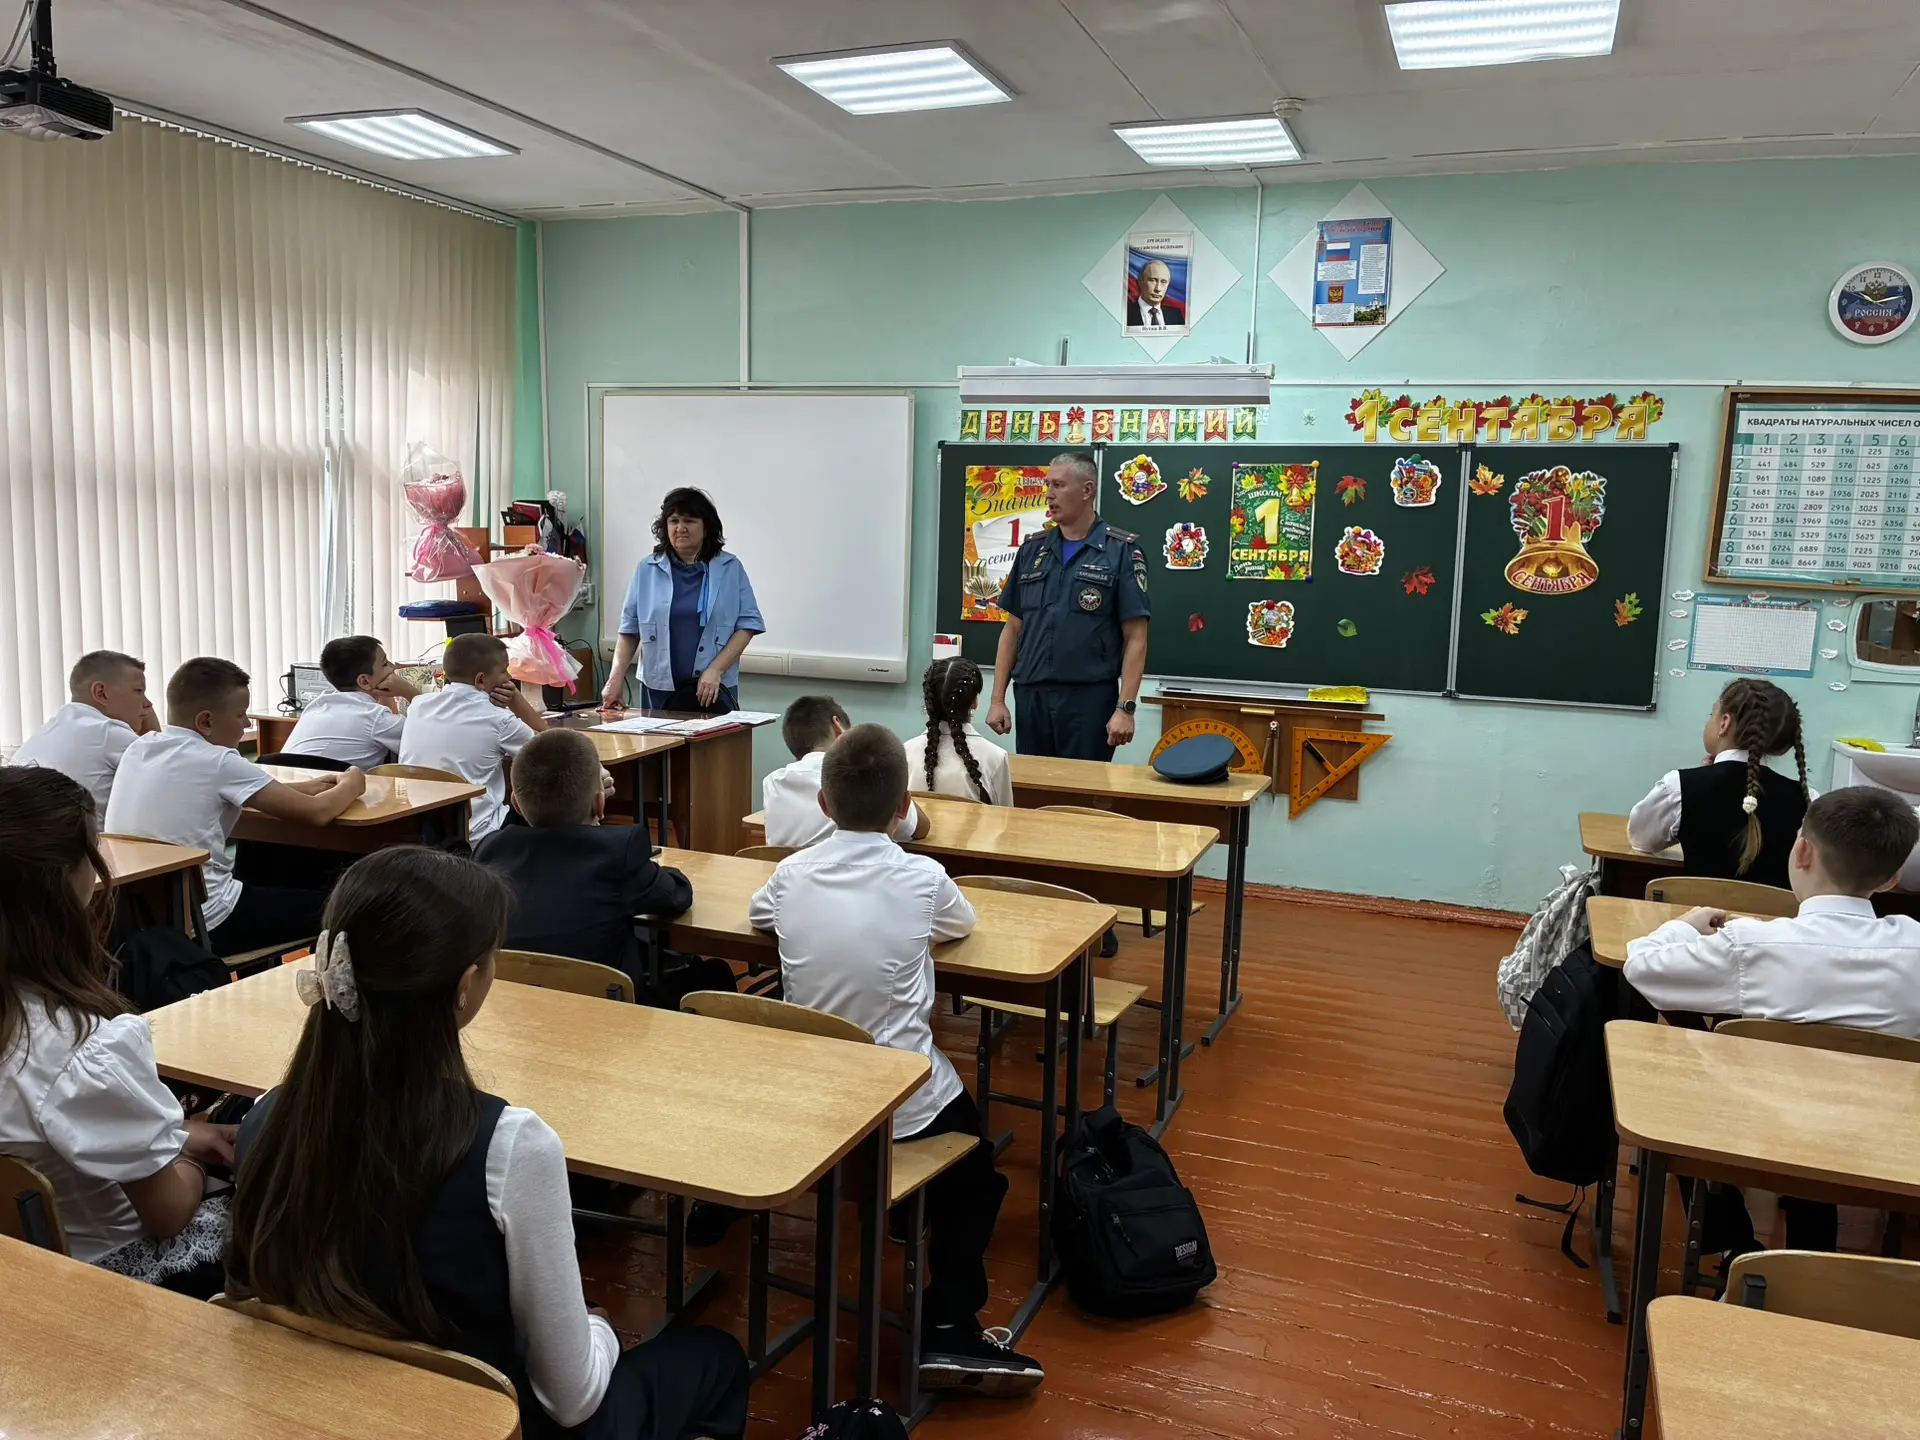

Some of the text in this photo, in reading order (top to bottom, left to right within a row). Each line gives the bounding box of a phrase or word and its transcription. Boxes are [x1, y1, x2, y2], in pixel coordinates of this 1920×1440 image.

[1854, 308, 1892, 316] РОССИЯ
[963, 408, 1254, 435] ДЕНЬ ЗНАНИЙ
[1354, 399, 1648, 442] 1 СЕНТЯБРЯ
[1748, 418, 1800, 426] КВАДРАТЫ
[1764, 433, 1907, 446] 1 2 3 4 5 6
[1740, 444, 1744, 455] 1
[1736, 458, 1744, 469] 2
[1734, 472, 1742, 483] 3
[1248, 490, 1282, 499] ШКОЛА!
[1733, 486, 1740, 497] 4
[971, 482, 1050, 515] Знани
[1732, 500, 1738, 511] 5
[1254, 498, 1280, 544] 1
[1541, 496, 1567, 542] 1
[1730, 514, 1737, 525] 6
[1008, 518, 1020, 548] 1
[1729, 528, 1736, 538] 7
[1726, 541, 1734, 552] 8
[988, 552, 1016, 565] сент
[1232, 548, 1309, 562] СЕНТЯБРЯ
[1725, 555, 1733, 566] 9
[1512, 568, 1594, 592] СЕНТЯБРЯ
[1175, 1240, 1197, 1258] DESIGN
